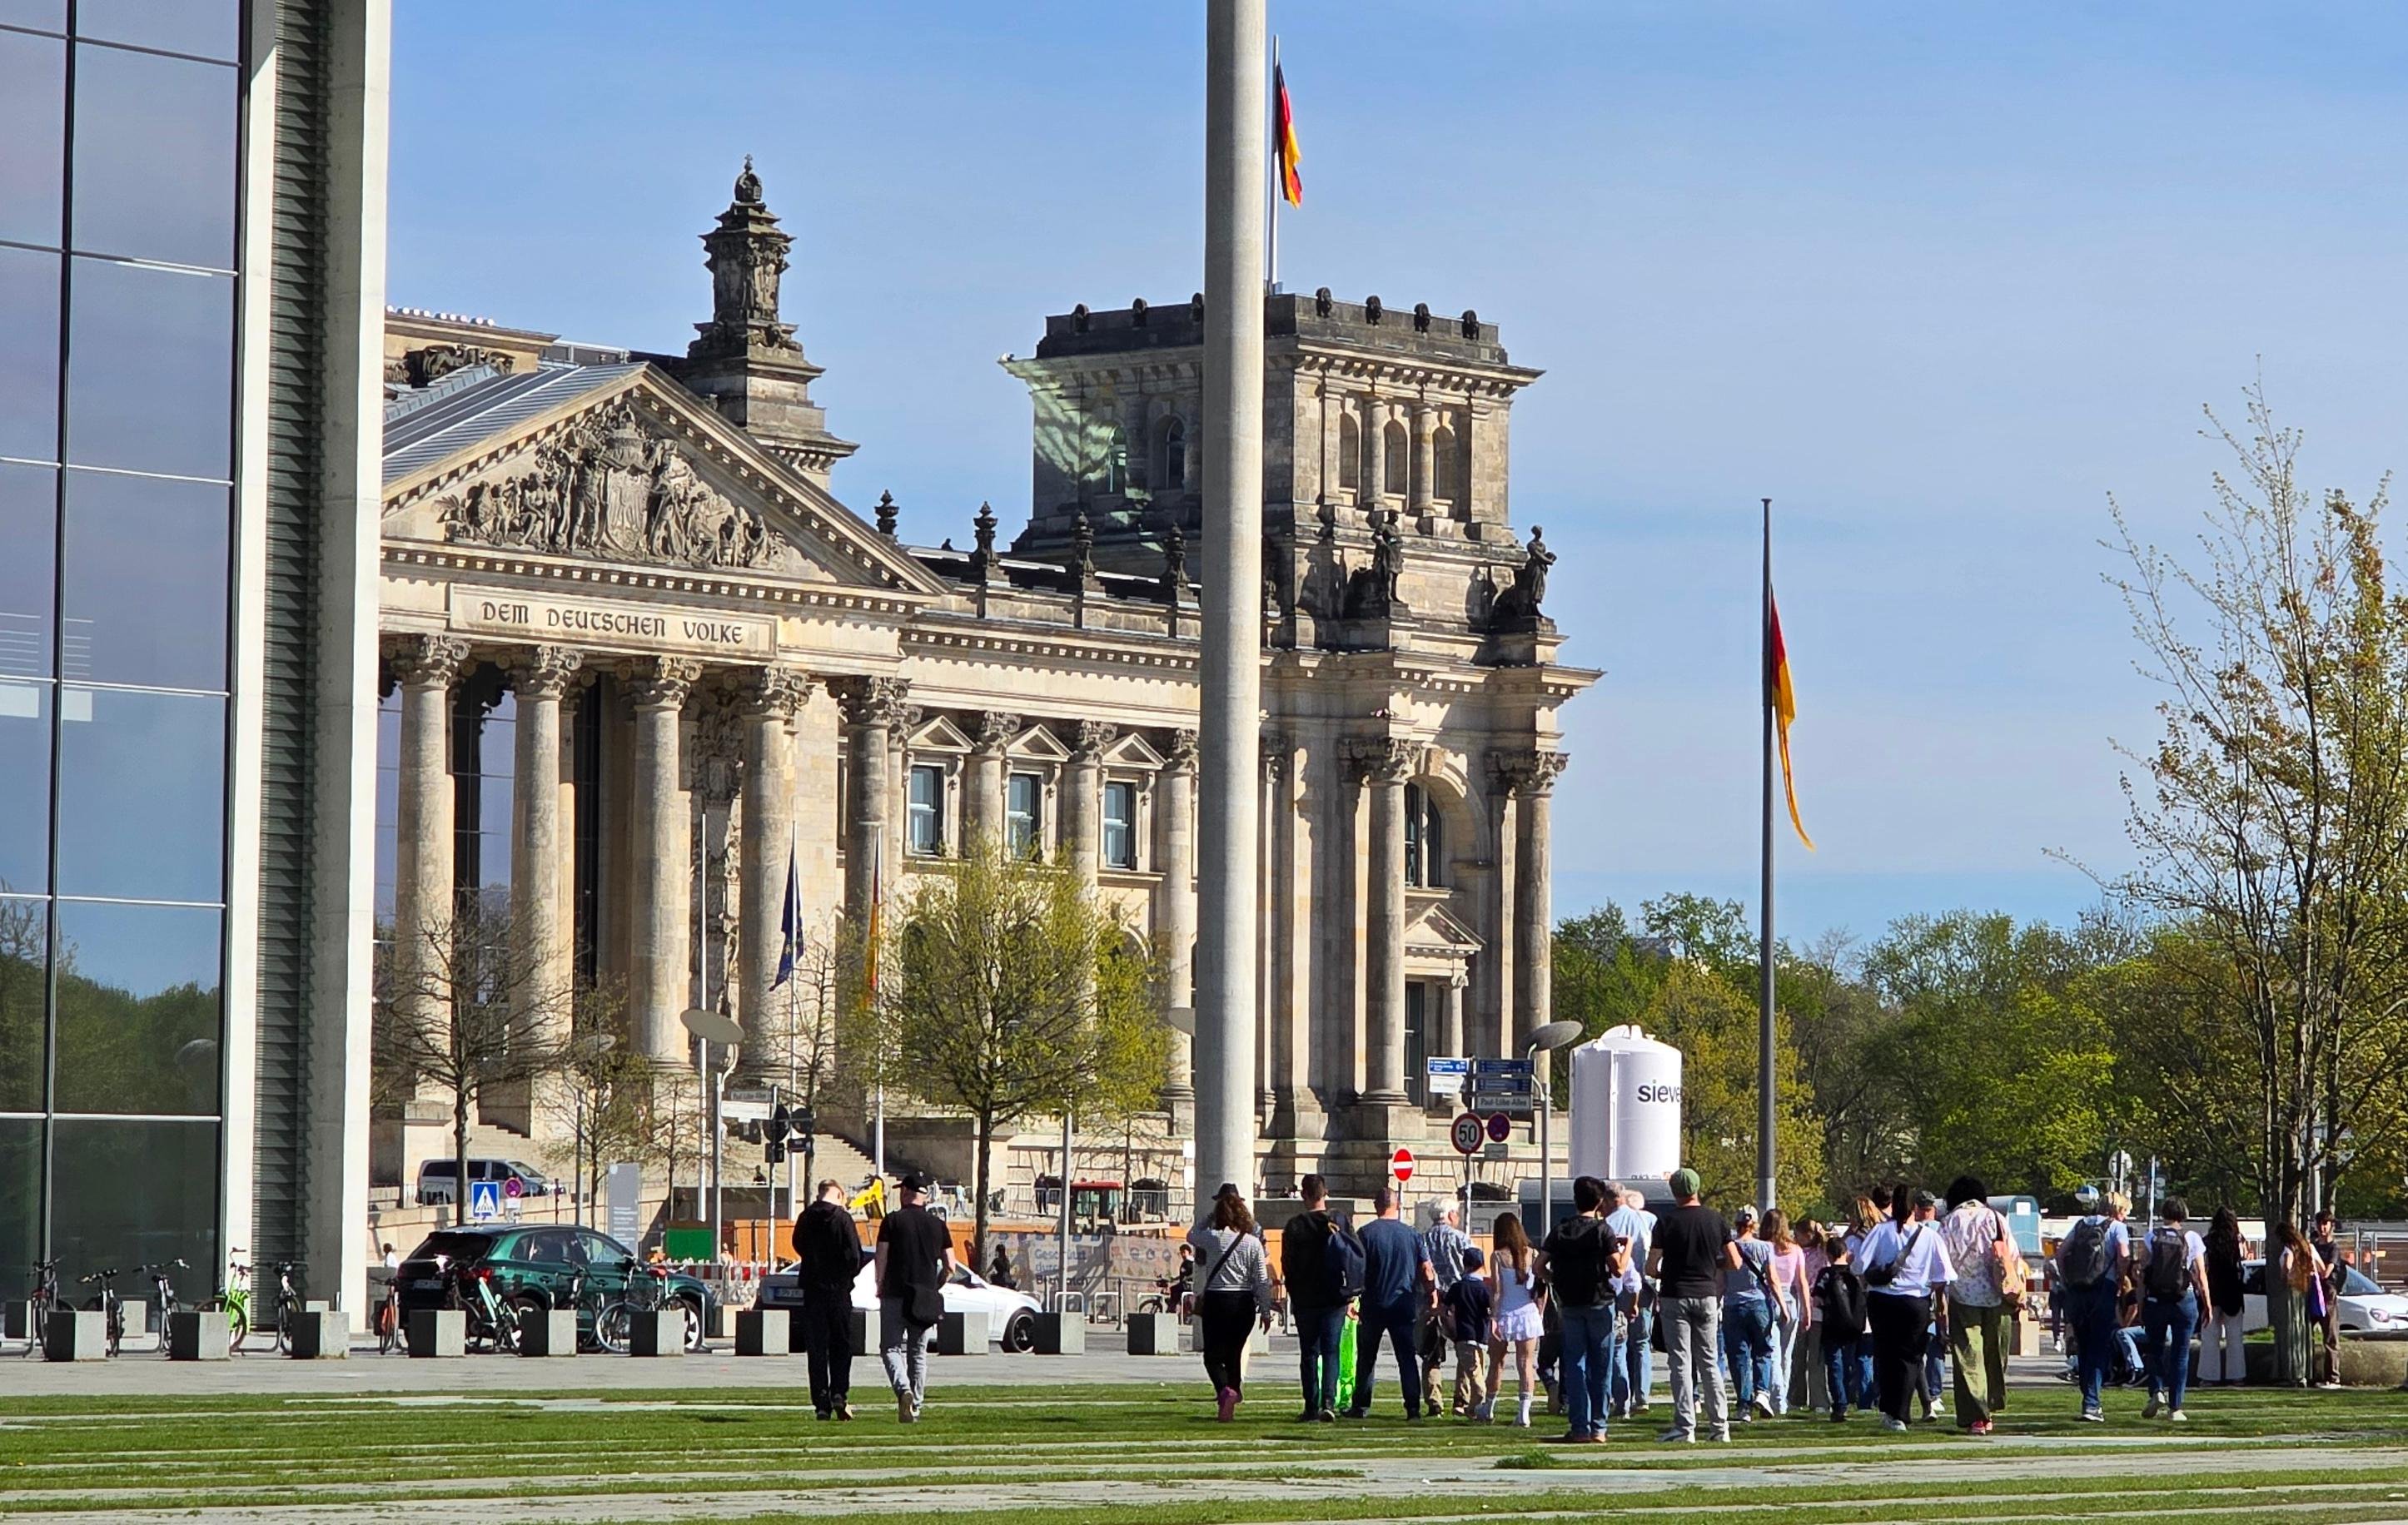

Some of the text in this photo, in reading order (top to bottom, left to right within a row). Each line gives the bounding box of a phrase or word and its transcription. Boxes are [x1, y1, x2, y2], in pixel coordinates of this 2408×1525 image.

[481, 601, 744, 644] DEM DEUTSCHEN VOLKE
[1458, 1124, 1478, 1143] 50
